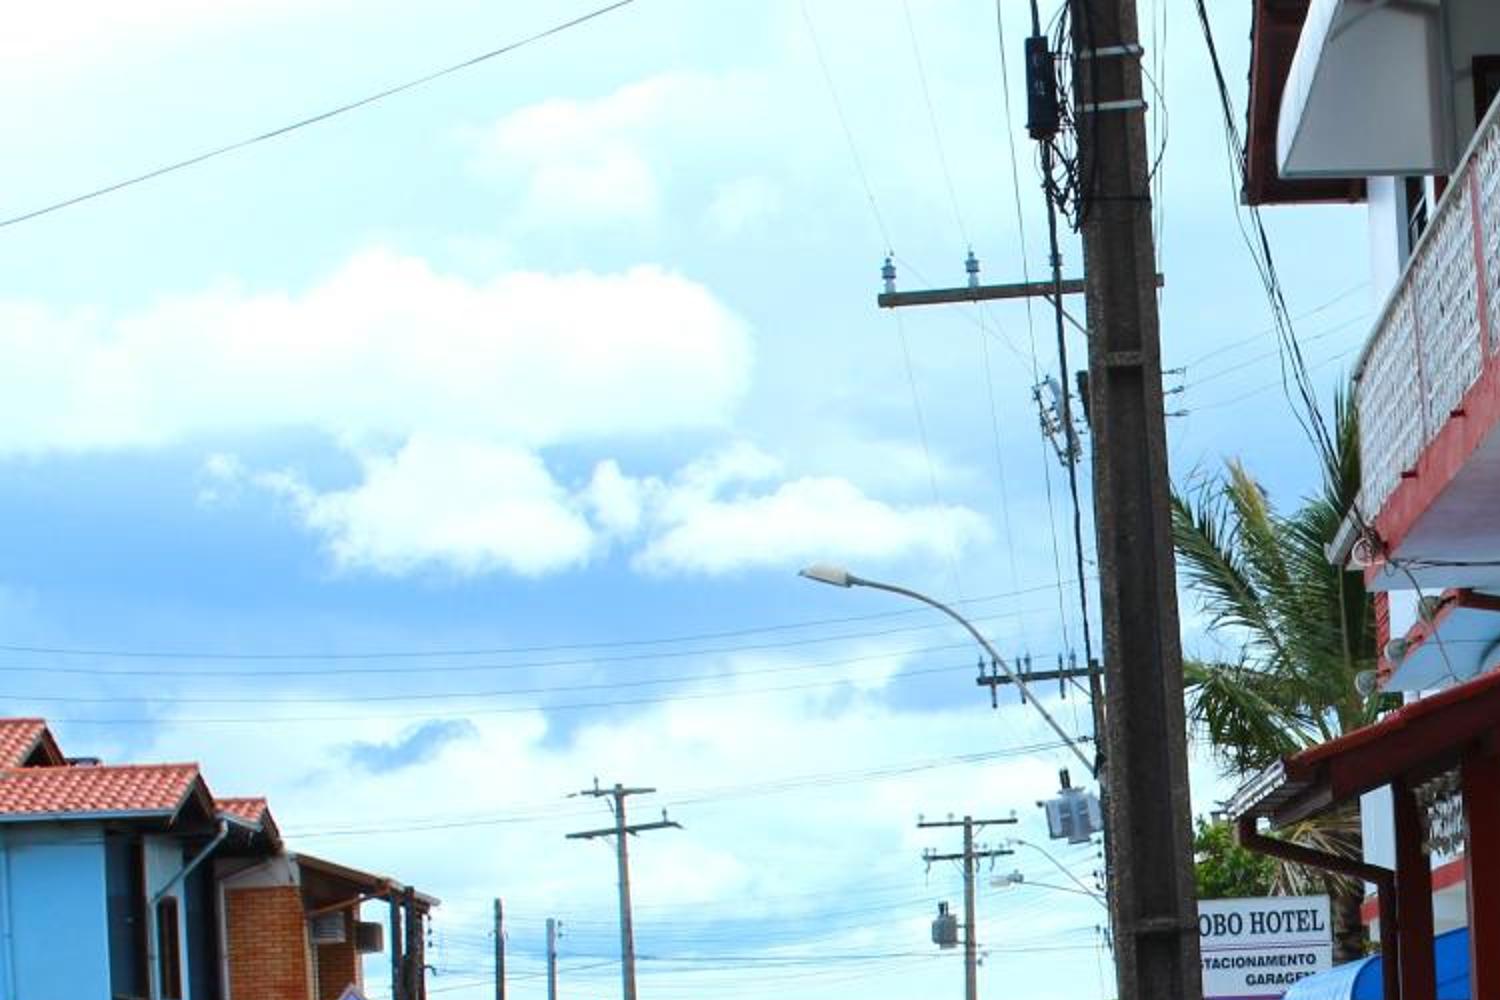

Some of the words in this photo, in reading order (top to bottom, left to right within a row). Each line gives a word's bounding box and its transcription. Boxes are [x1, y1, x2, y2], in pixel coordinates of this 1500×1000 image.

[1200, 912, 1243, 937] OBO
[1250, 909, 1325, 935] HOTEL
[1201, 953, 1317, 970] TACIONAMENTO
